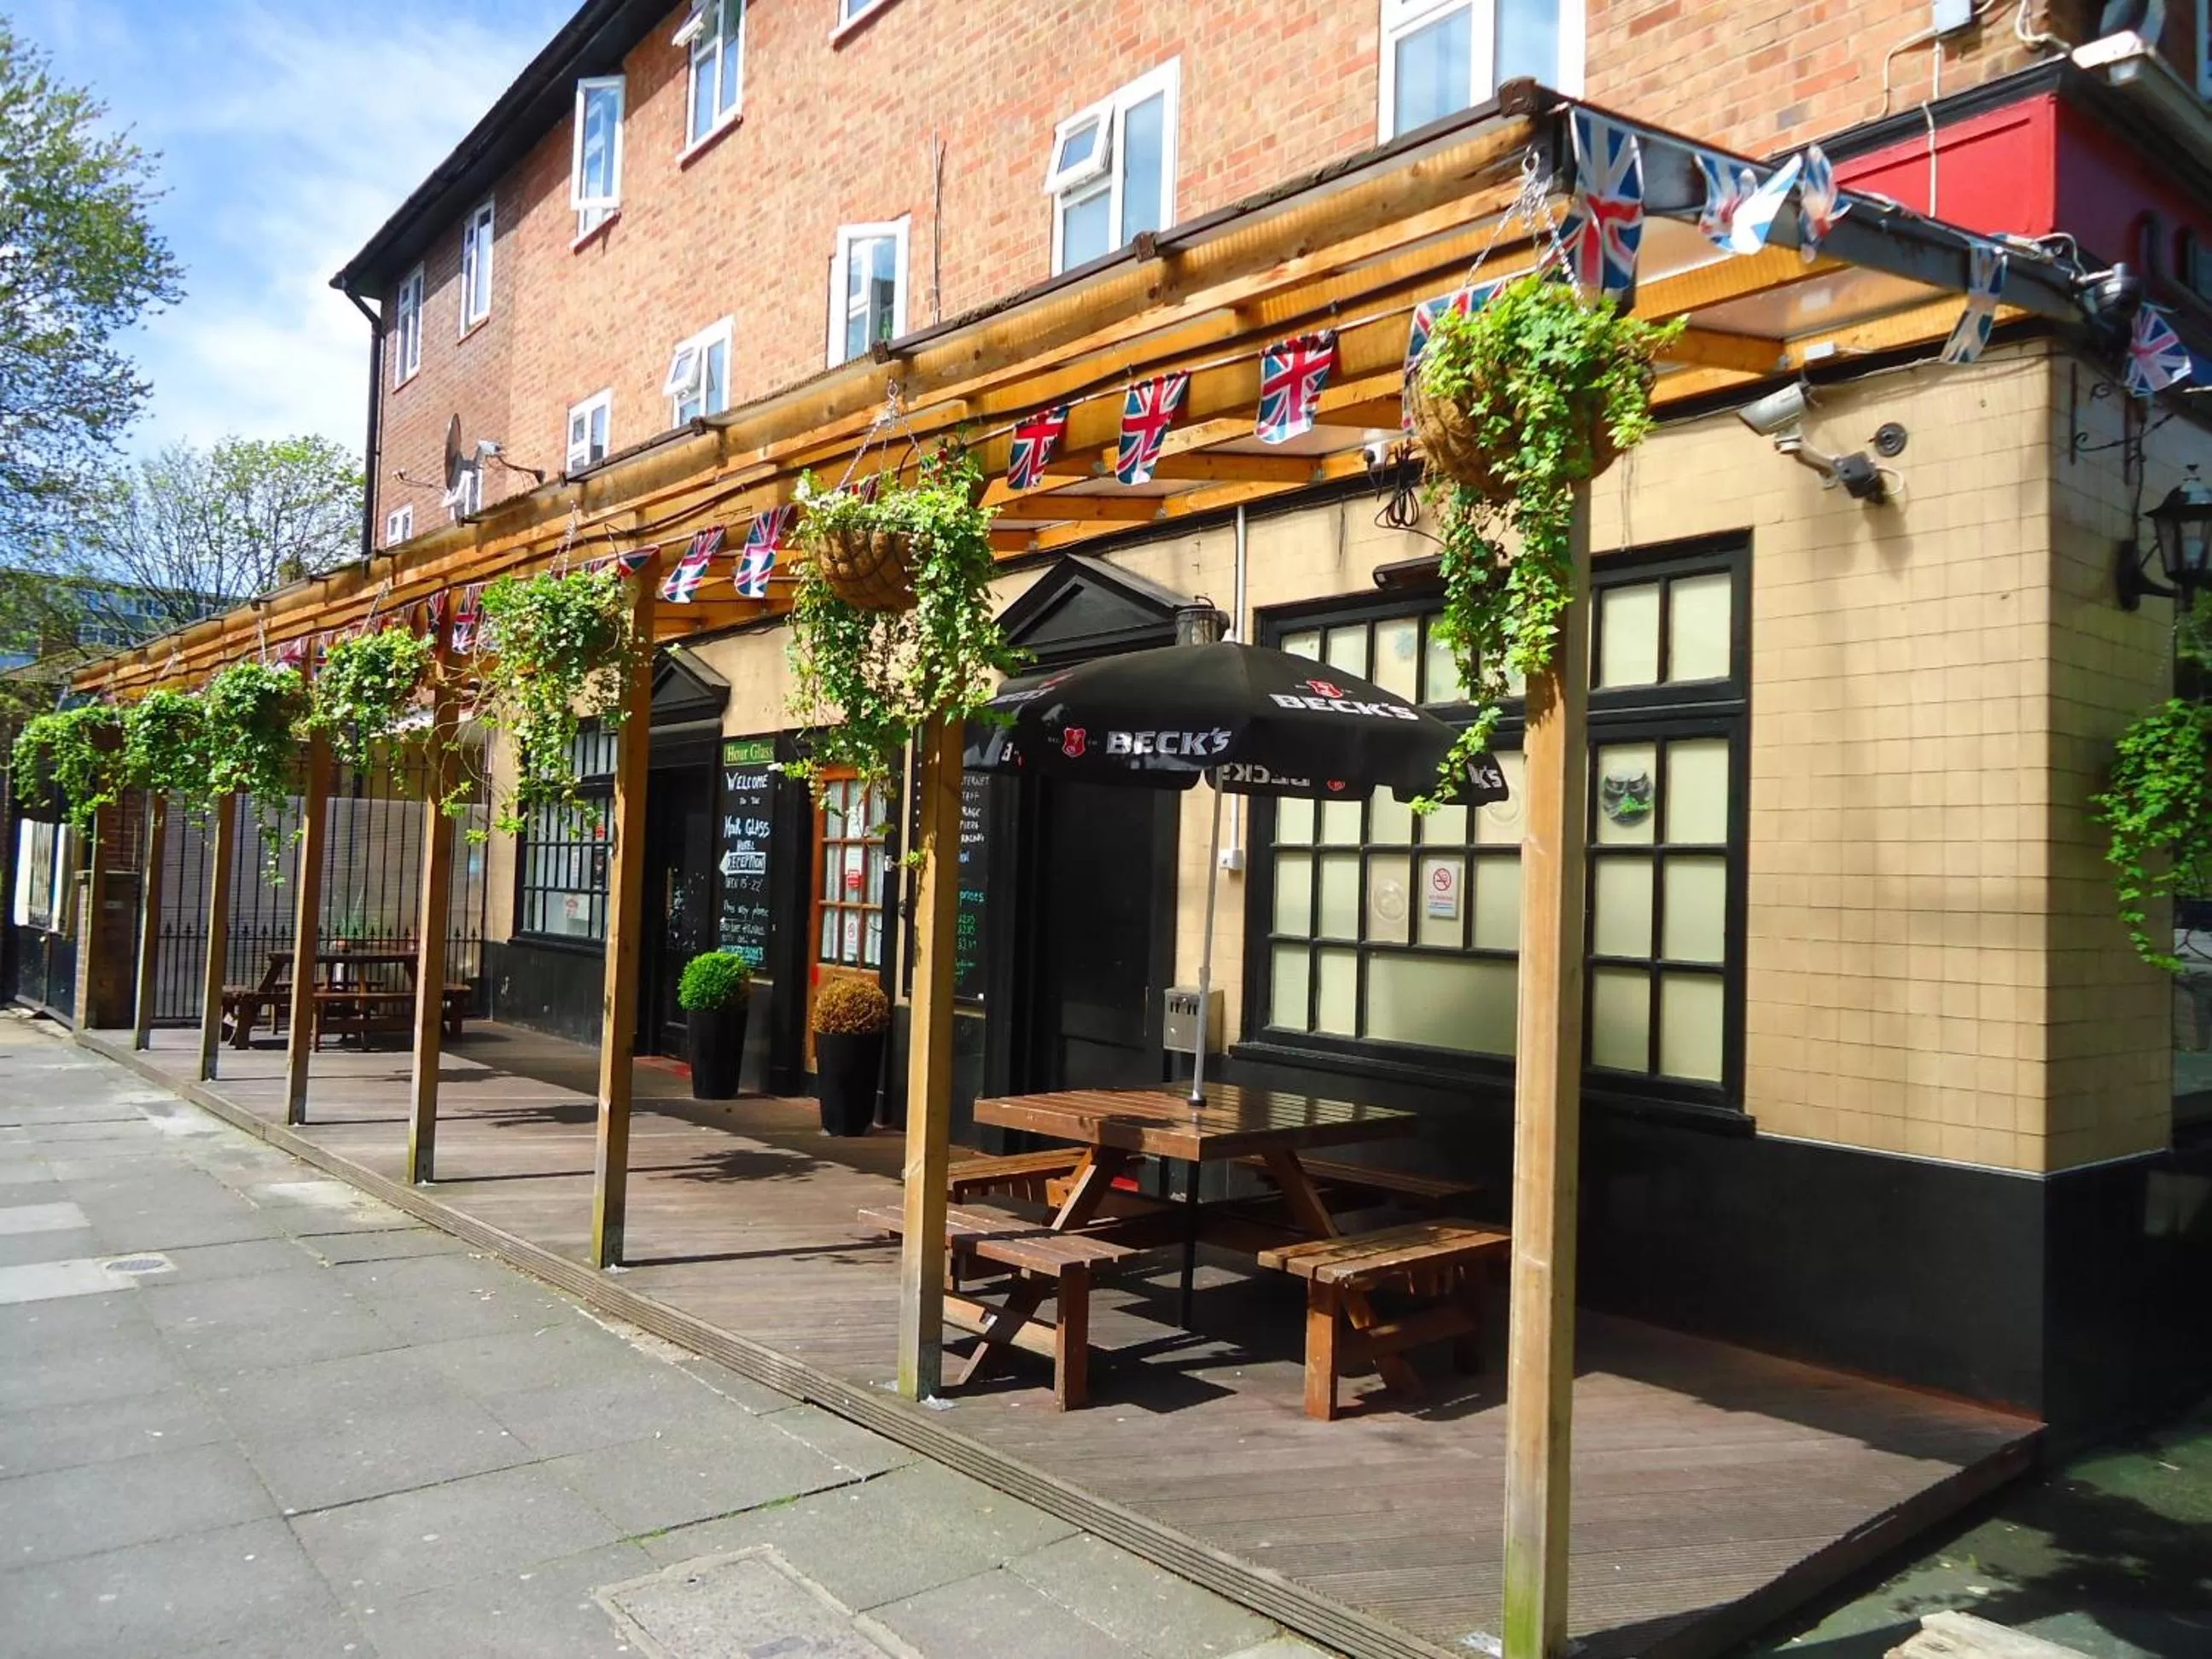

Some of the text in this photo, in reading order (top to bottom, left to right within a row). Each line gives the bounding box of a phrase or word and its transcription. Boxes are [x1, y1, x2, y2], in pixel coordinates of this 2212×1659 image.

[1269, 693, 1419, 720] BECK'S
[1106, 727, 1232, 755] BECK'S
[727, 743, 773, 761] Hour Glass
[726, 772, 769, 791] WELCOME
[745, 818, 771, 838] GLASS
[726, 854, 764, 870] RECEPTION
